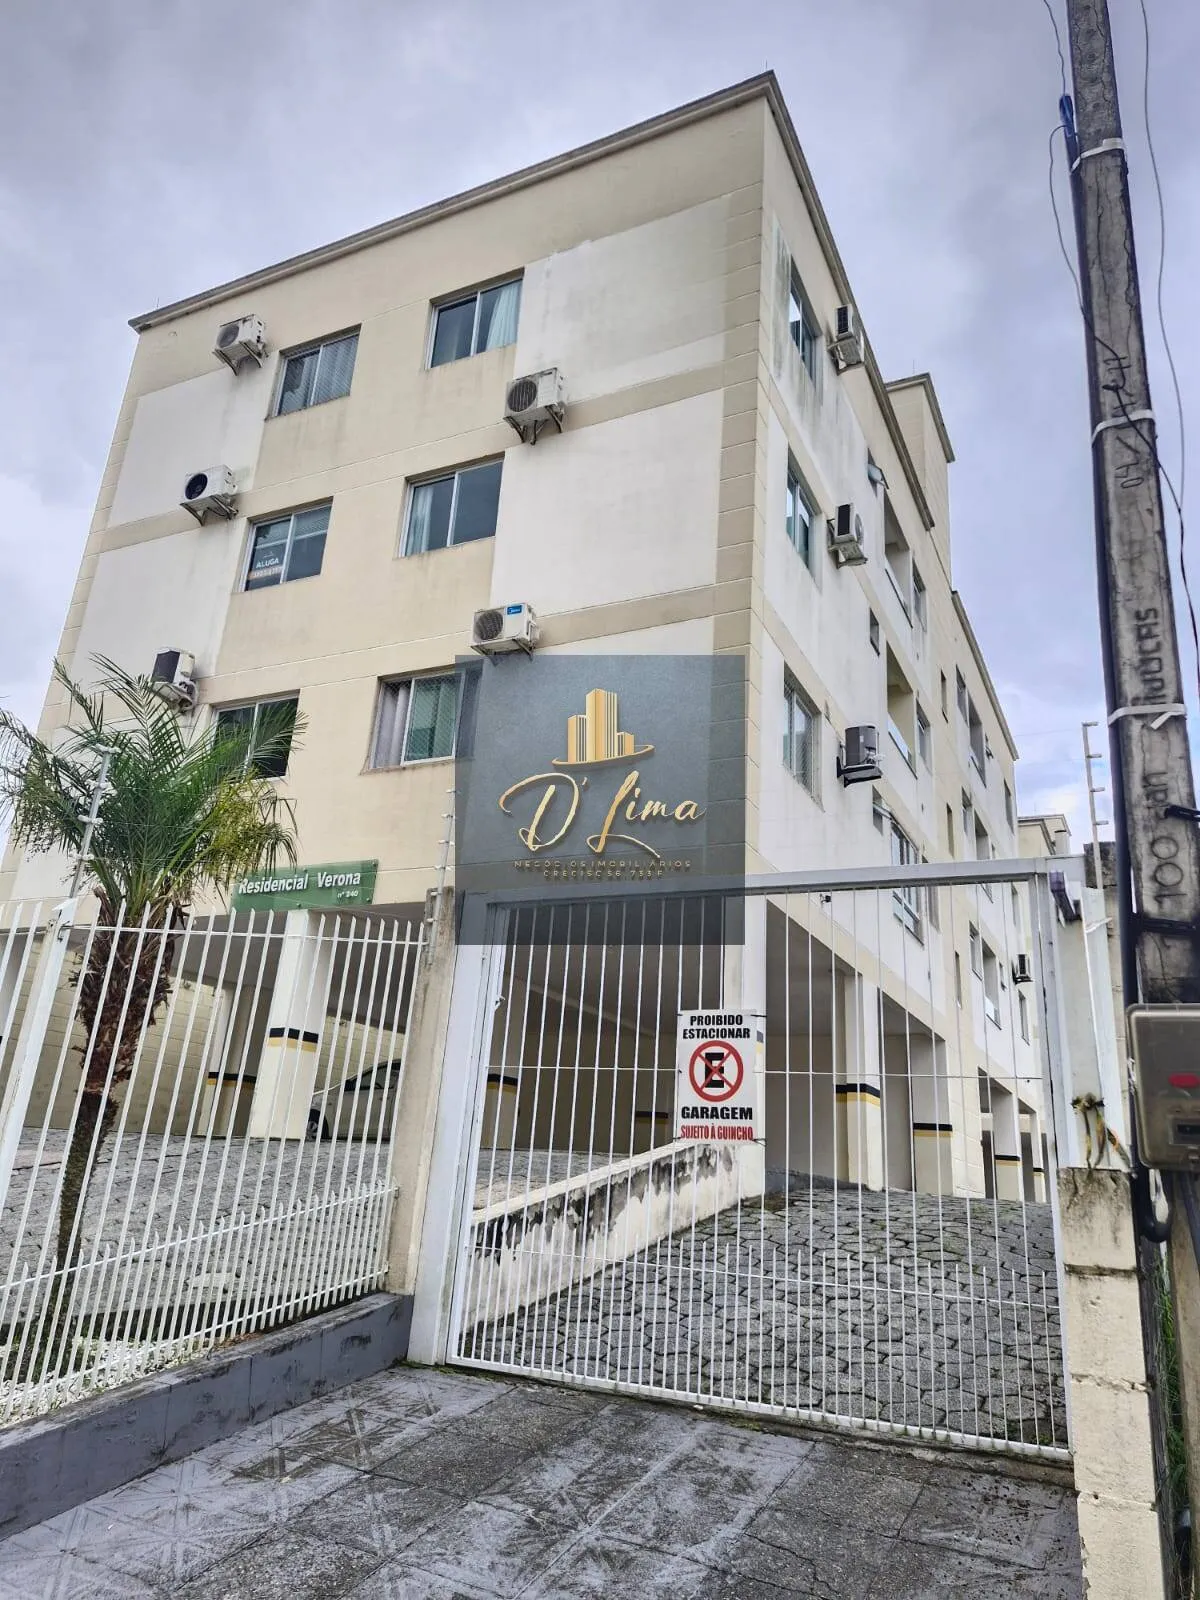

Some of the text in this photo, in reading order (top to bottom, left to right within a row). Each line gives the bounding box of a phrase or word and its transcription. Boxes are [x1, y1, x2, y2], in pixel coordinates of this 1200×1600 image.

[255, 557, 280, 569] ALUGA
[238, 871, 361, 895] Residencial Verona
[690, 1014, 743, 1026] PROIBIDO
[682, 1028, 751, 1040] ESTACIONAR
[681, 1106, 753, 1120] GARAGEM
[680, 1124, 710, 1139] SUJEITO
[718, 1126, 754, 1141] GUINCHO
